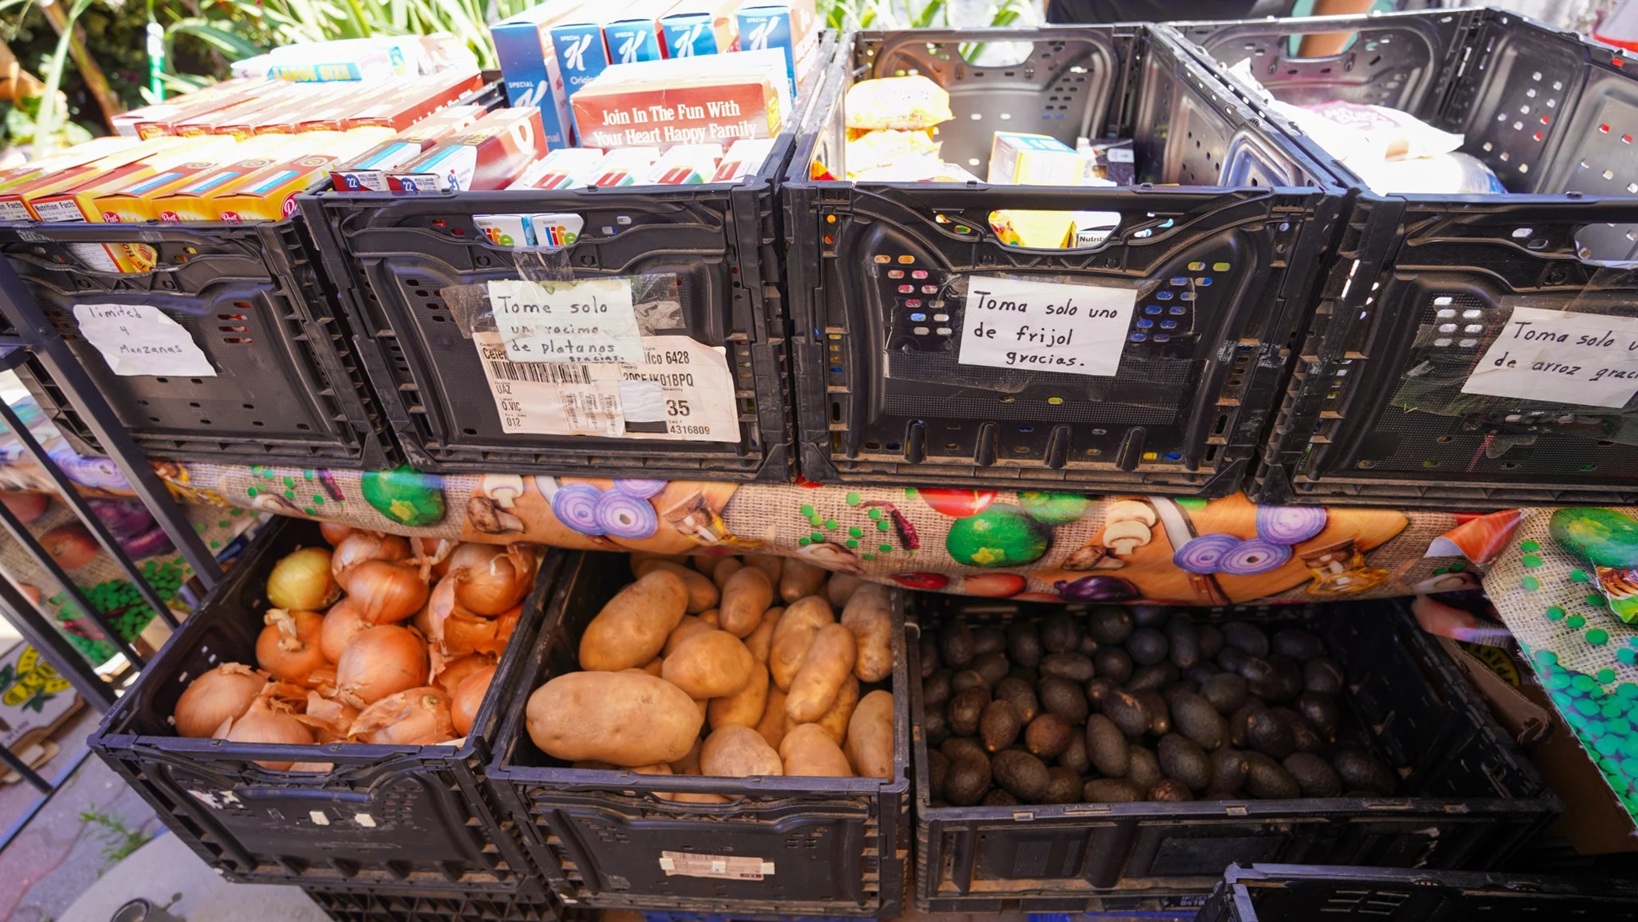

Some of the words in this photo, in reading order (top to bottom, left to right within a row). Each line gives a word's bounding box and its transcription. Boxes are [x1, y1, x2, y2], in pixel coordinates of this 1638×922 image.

[564, 34, 593, 71] K
[602, 109, 631, 126] Join
[632, 108, 648, 123] In
[649, 105, 675, 121] The
[677, 104, 705, 119] Fun
[706, 100, 741, 118] With
[592, 131, 623, 146] Your
[625, 128, 662, 144] Heart
[664, 126, 706, 145] Happy
[709, 121, 757, 140] Family
[34, 204, 59, 212] Nutrition
[103, 213, 118, 222] Post
[545, 225, 577, 246] life
[497, 296, 552, 314] Tome
[570, 296, 608, 313] solo
[973, 290, 1028, 313] Toma
[1045, 298, 1078, 316] solo
[1088, 307, 1118, 319] uno
[119, 326, 130, 336] 4
[511, 326, 530, 334] un
[545, 324, 599, 334] racimo
[973, 322, 996, 339] de
[1016, 325, 1073, 347] frijol
[1514, 321, 1569, 343] Toma
[1576, 330, 1615, 347] solo
[120, 344, 182, 354] Manzanas
[512, 339, 531, 352] de
[541, 339, 615, 354] platanos
[665, 351, 690, 364] 6428
[1006, 352, 1085, 367] gracias.
[1494, 352, 1517, 368] de
[1531, 361, 1582, 375] arroz
[666, 399, 690, 416] 35
[670, 425, 710, 435] 4316809
